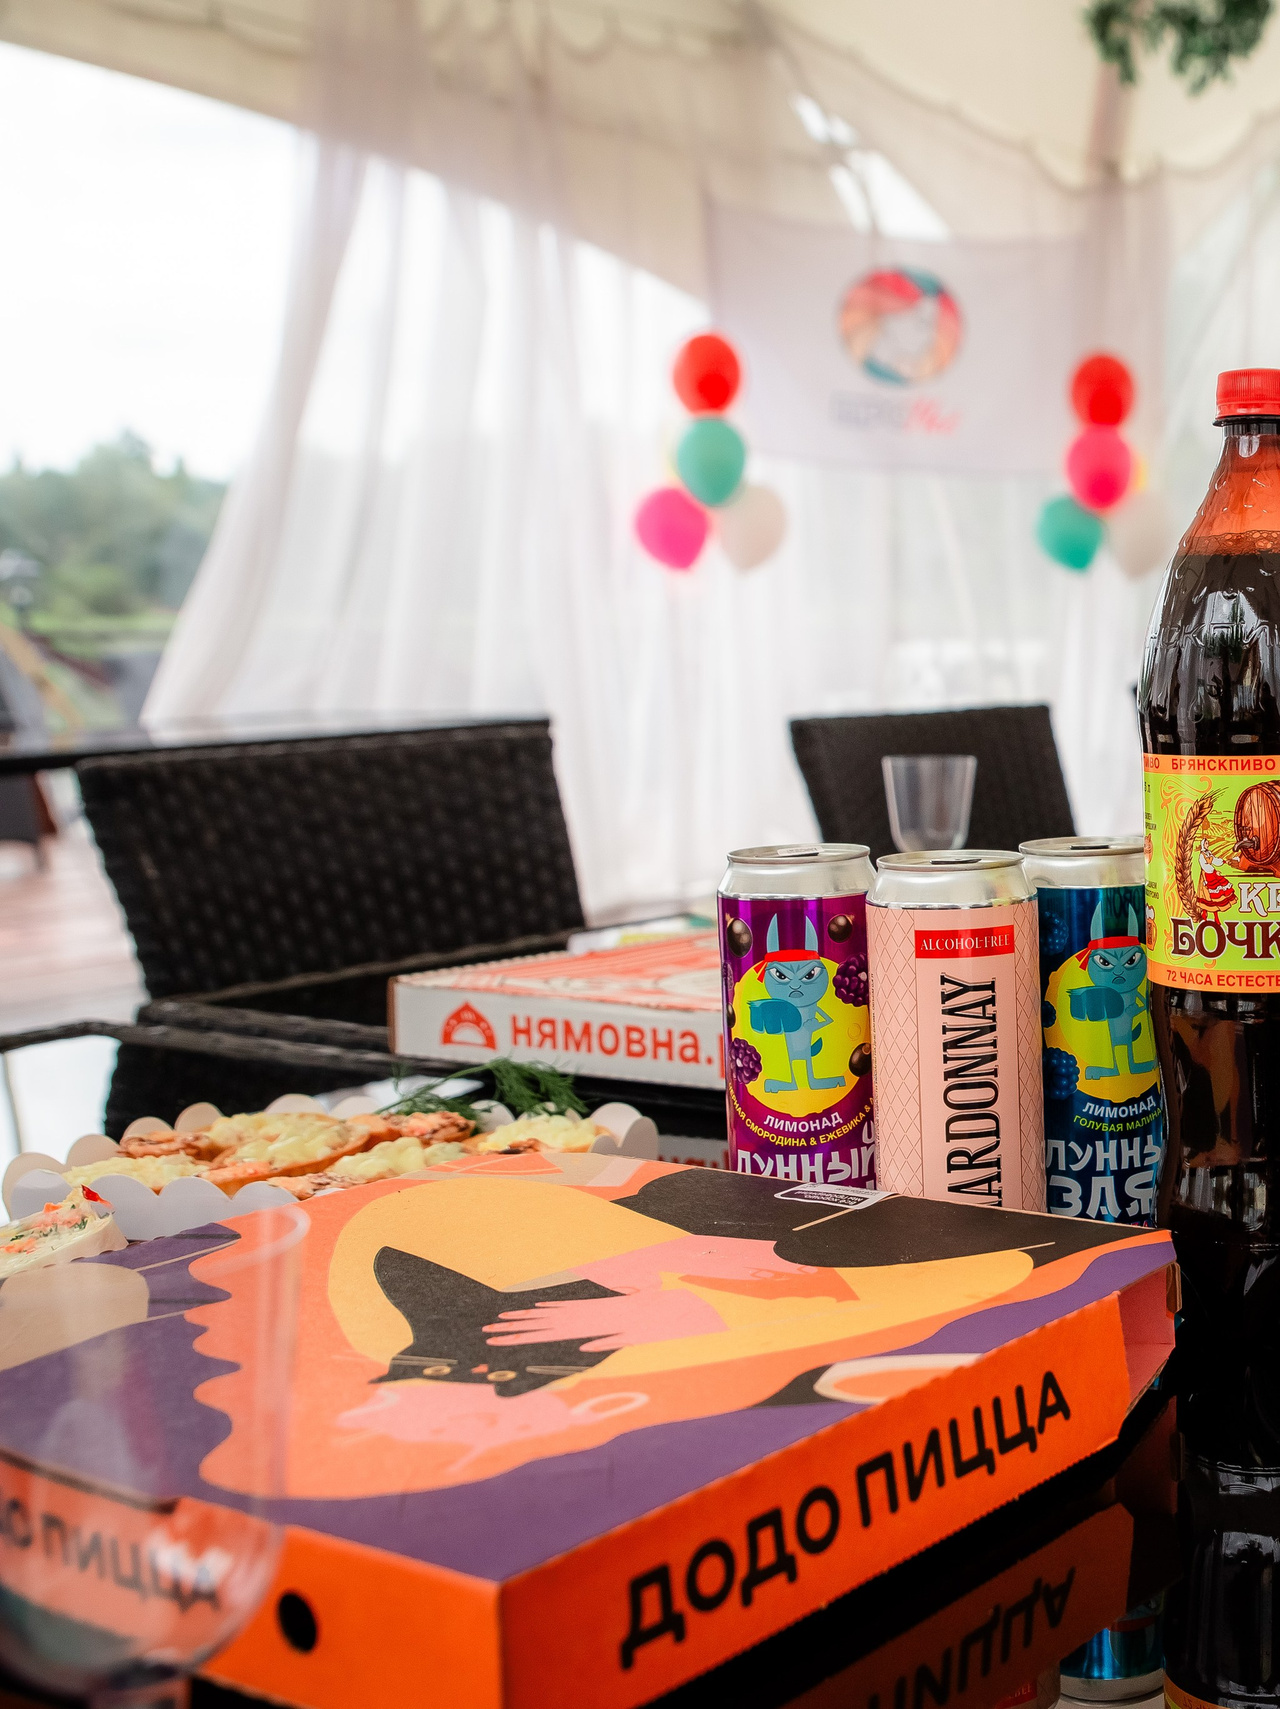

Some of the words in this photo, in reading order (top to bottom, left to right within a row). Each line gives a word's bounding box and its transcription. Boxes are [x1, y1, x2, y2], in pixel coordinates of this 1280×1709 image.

[1171, 758, 1276, 772] БРЯНСКПИВО
[920, 933, 1010, 951] ALCOHOL-FREE
[1166, 969, 1177, 982] 72
[1180, 971, 1213, 986] ЧАСА
[940, 971, 1003, 1207] ARDONNAY
[1082, 1095, 1157, 1119] ЛИМОНАД
[745, 1118, 808, 1147] СМОРОДИНА
[809, 1137, 818, 1146] &
[819, 1111, 867, 1144] ЕЖЕВИКА
[763, 1111, 844, 1133] ЛИМОНАД
[1073, 1115, 1124, 1132] ГОЛУБАЯ
[1126, 1107, 1163, 1131] МАЛИНА
[619, 1485, 841, 1671] ДОДО
[855, 1370, 1072, 1528] ПИЦЦА
